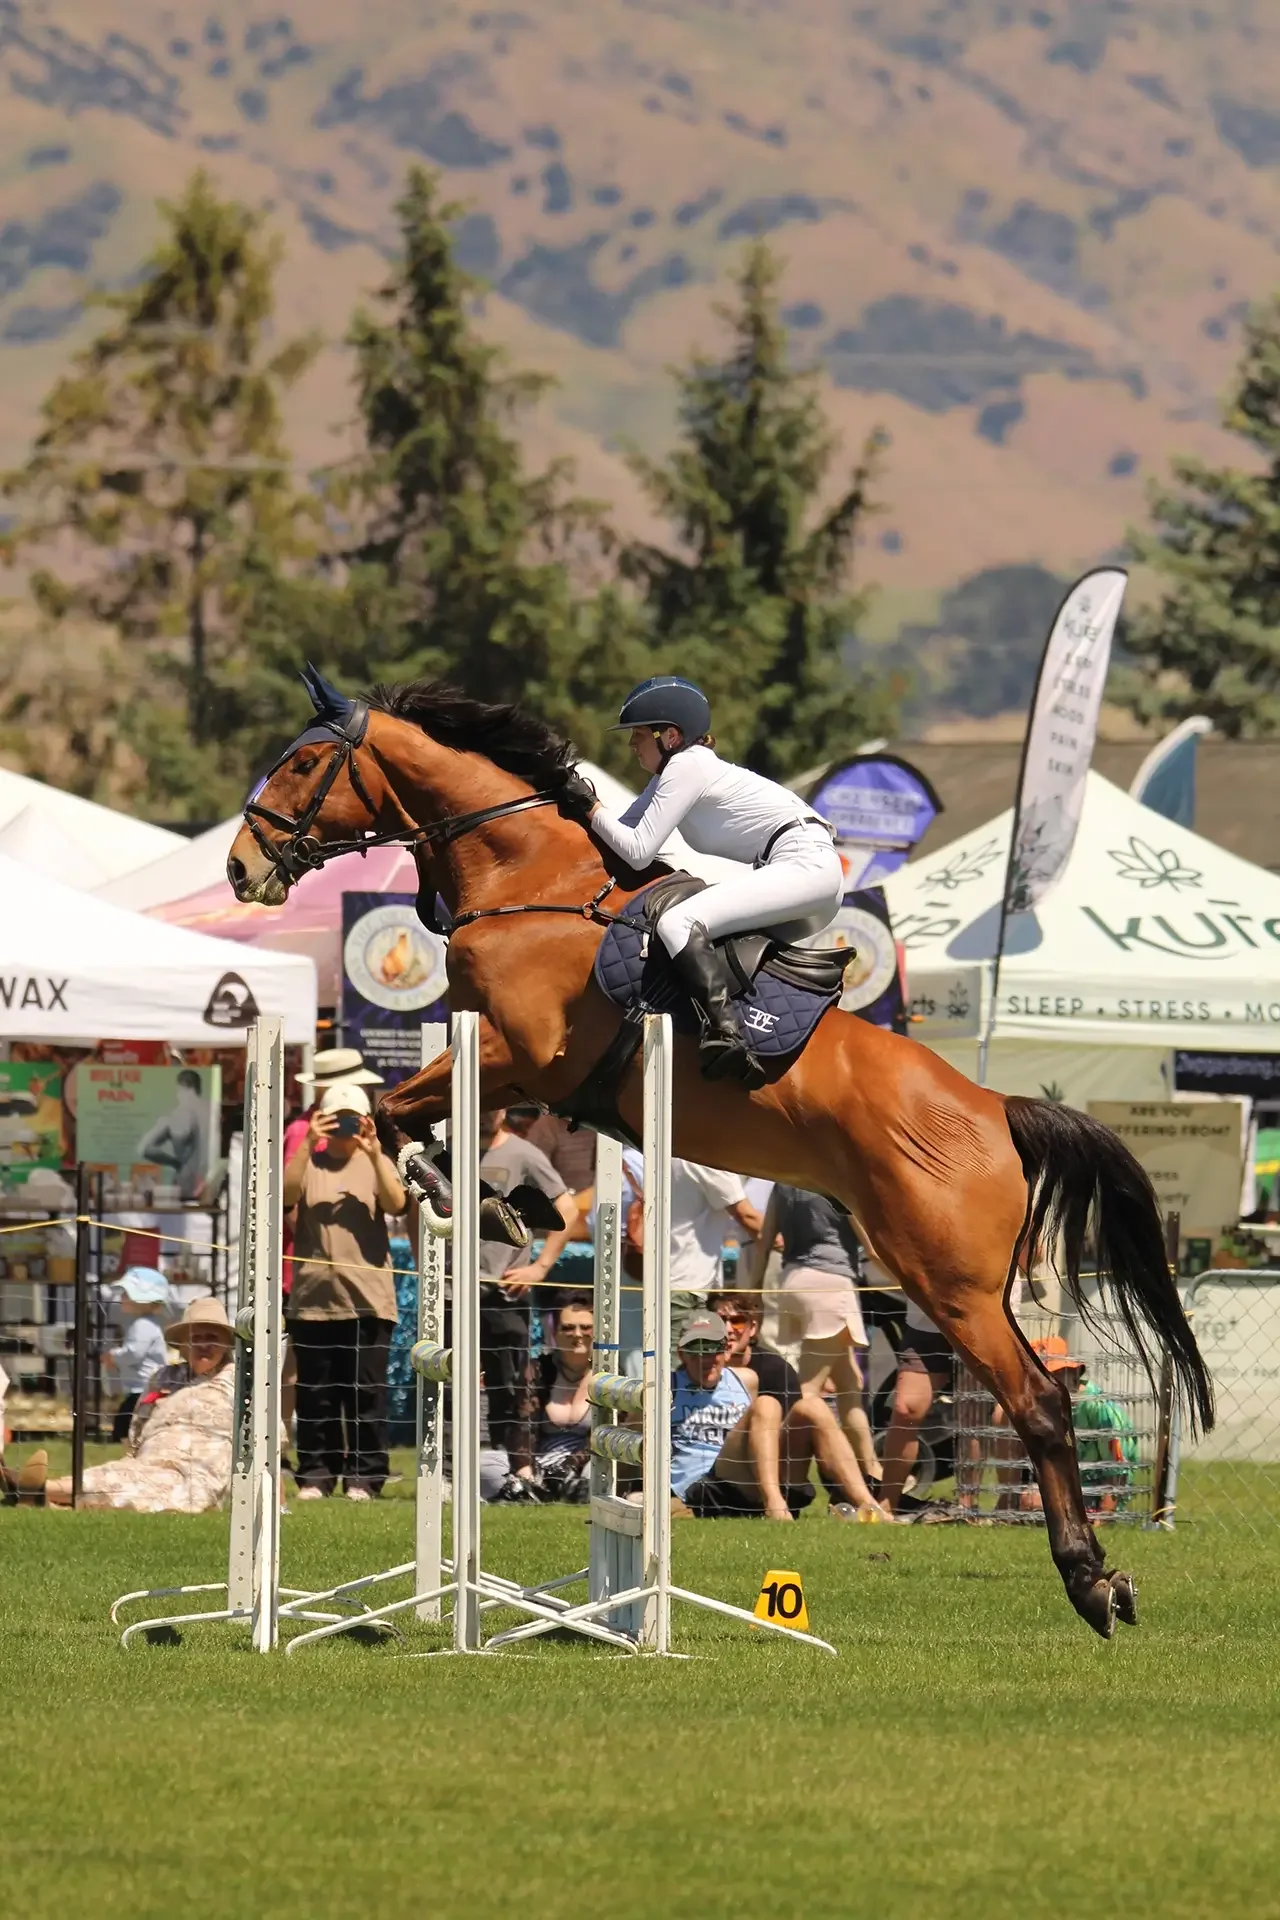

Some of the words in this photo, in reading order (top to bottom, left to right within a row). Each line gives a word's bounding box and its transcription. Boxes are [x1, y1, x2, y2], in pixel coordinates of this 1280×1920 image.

[1050, 731, 1078, 750] PAIN
[1007, 995, 1084, 1018] SLEEP
[1117, 999, 1211, 1021] STRESS
[1130, 1105, 1157, 1117] ARE
[1161, 1105, 1194, 1119] YOU
[761, 1582, 803, 1619] 10
